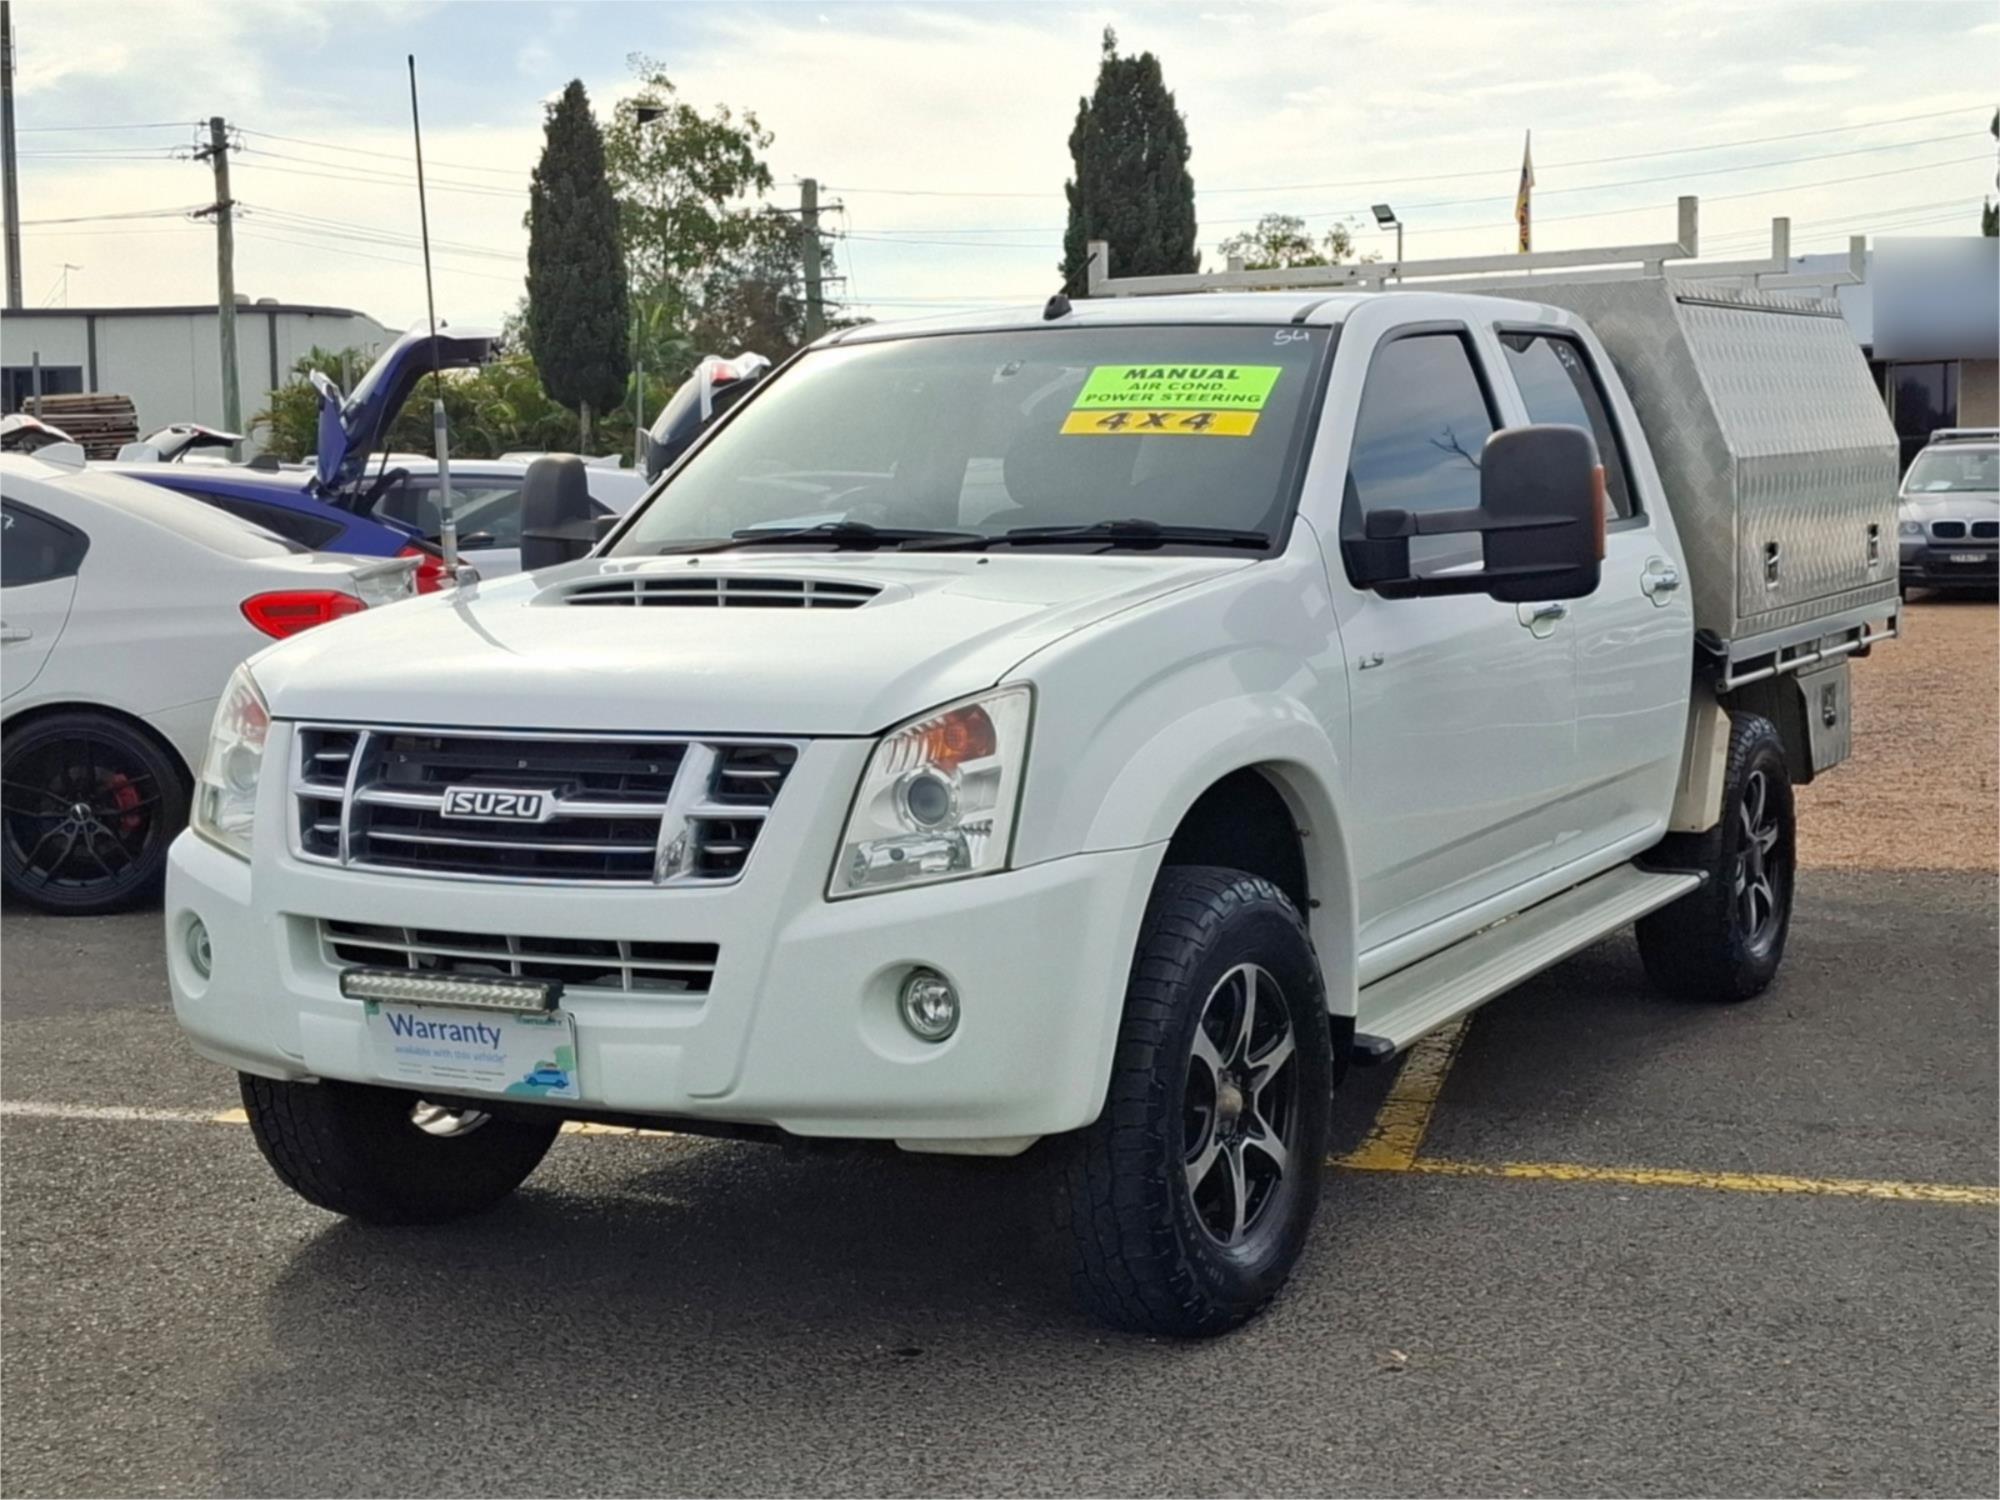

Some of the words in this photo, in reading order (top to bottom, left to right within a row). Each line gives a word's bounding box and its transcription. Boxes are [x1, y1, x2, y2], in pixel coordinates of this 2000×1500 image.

[1123, 368, 1240, 380] MANUAL
[1128, 382, 1162, 391] AIR
[1167, 382, 1228, 391] COND.
[1085, 393, 1155, 403] POWER
[1160, 393, 1261, 403] STEERING
[446, 792, 539, 816] ISUZU
[386, 1011, 502, 1049] Warranty
